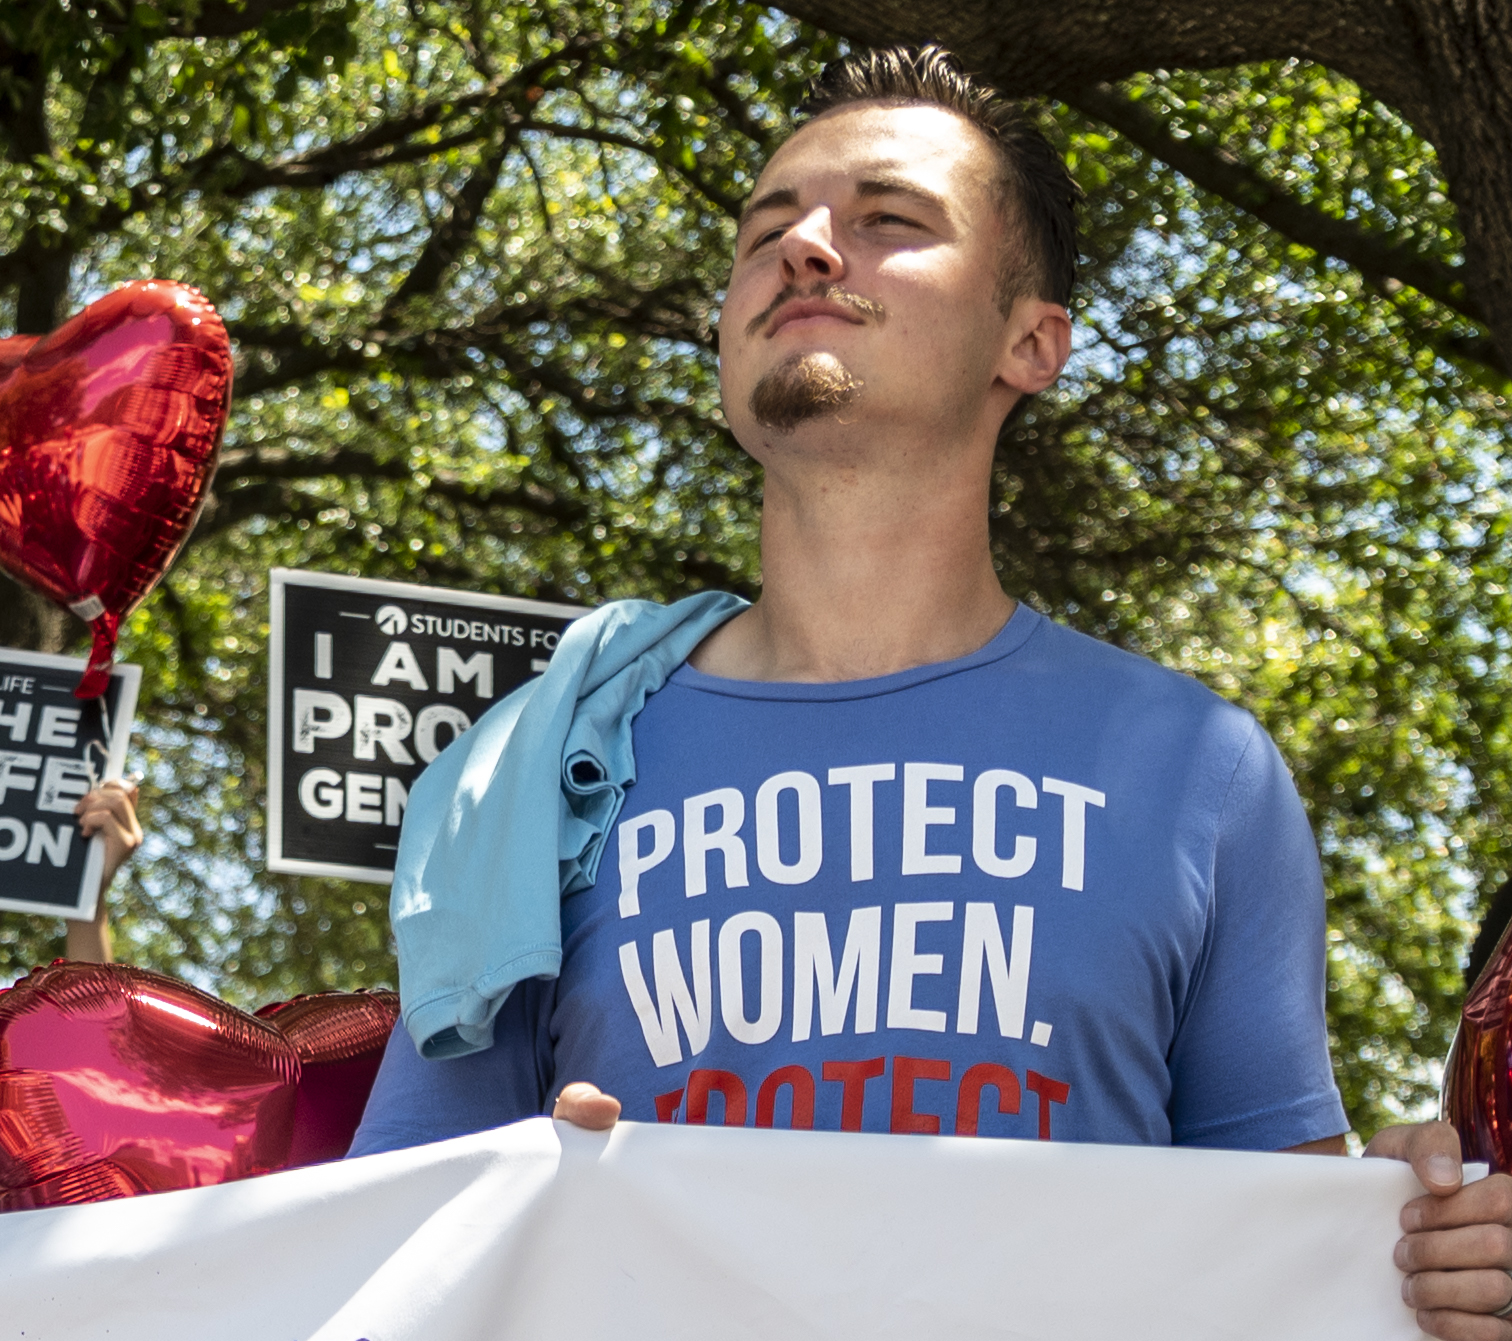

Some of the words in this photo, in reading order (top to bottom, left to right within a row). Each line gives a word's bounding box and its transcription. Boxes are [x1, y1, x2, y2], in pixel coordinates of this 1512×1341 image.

[314, 631, 333, 679] I
[371, 641, 493, 699] AM
[411, 614, 525, 647] STUDENTS
[616, 762, 1106, 919] PROTECT
[618, 901, 1054, 1067] WOMEN.
